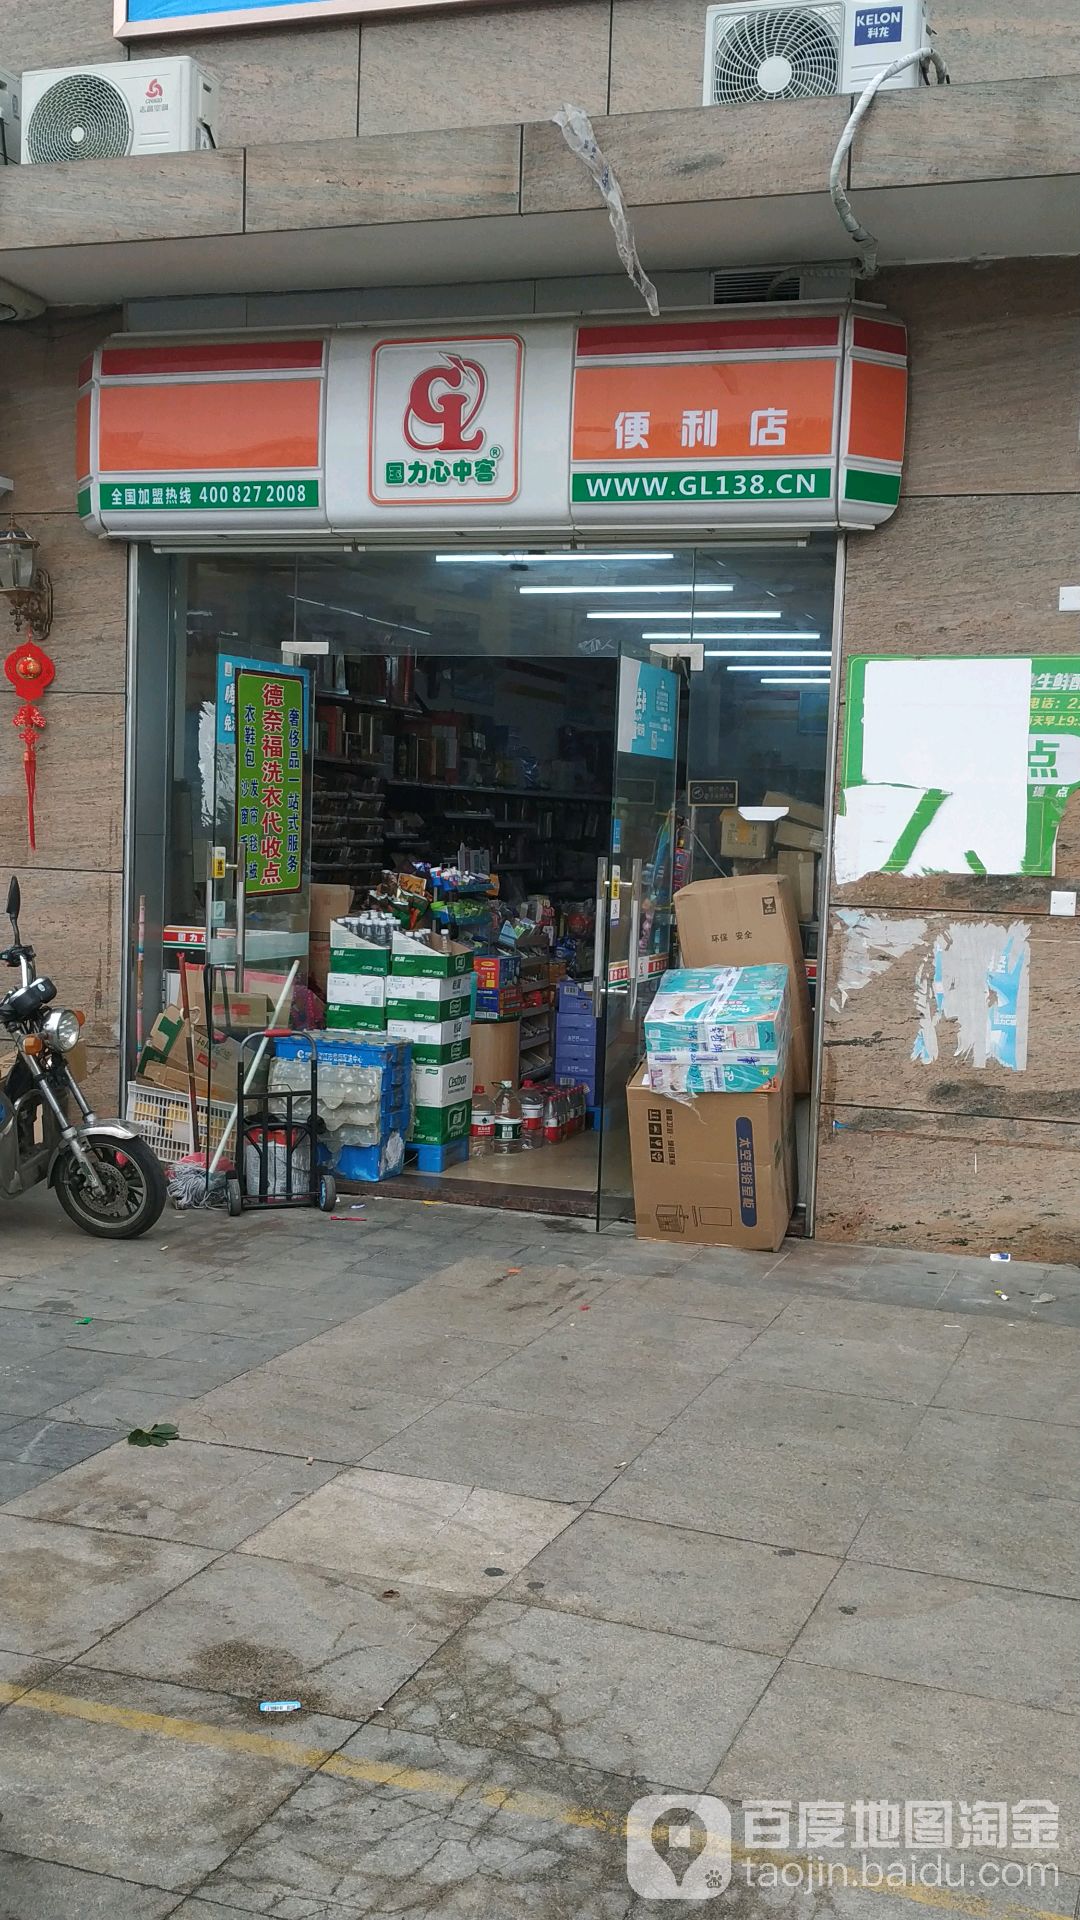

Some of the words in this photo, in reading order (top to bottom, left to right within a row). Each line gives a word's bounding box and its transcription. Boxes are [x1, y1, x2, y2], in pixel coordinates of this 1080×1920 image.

[857, 12, 900, 27] KELON
[867, 26, 890, 39] 科龙
[614, 408, 788, 450] 便利店
[385, 459, 498, 486] 国力心中客
[111, 487, 192, 506] 全国加盟热线
[586, 474, 816, 497] WWW.GL138.CN
[244, 703, 256, 768] 衣鞋包
[1028, 739, 1060, 778] 点
[240, 778, 259, 798] 沙发
[261, 683, 284, 886] 德奈福洗衣代收点
[286, 708, 300, 874] 奢侈品一站式服务
[711, 933, 729, 943] 环保
[735, 930, 753, 941] 安全
